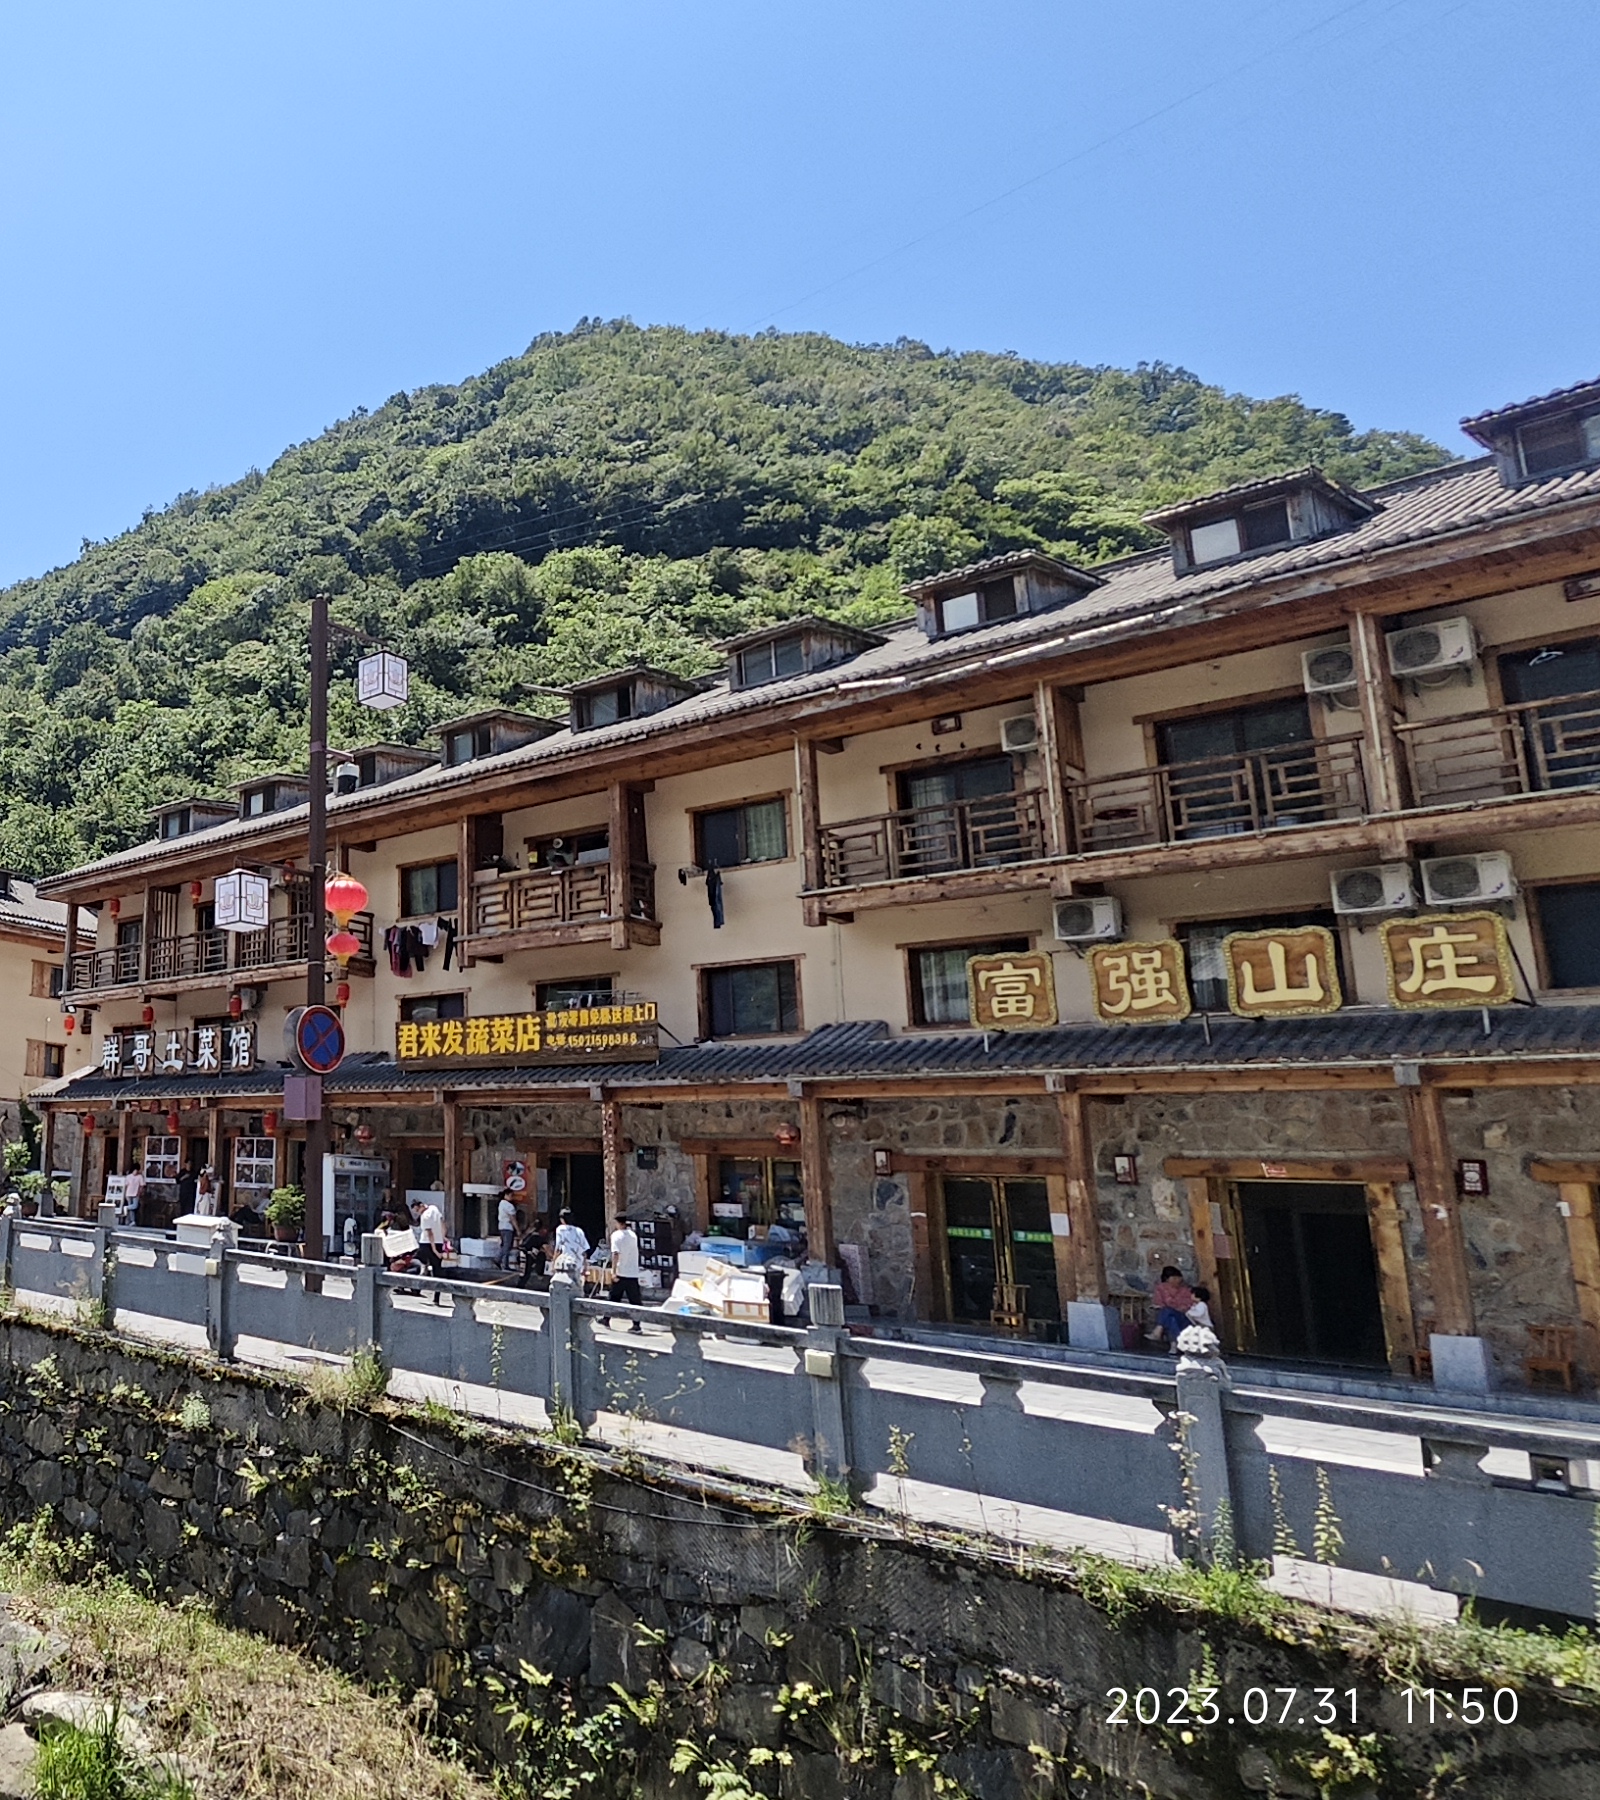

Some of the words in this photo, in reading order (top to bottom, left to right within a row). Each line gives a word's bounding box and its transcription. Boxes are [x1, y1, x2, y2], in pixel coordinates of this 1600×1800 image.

[977, 926, 1497, 1019] 富强山庄
[101, 1026, 251, 1075] 群哥土菜馆
[398, 1013, 541, 1058] 君来发蔬菜店
